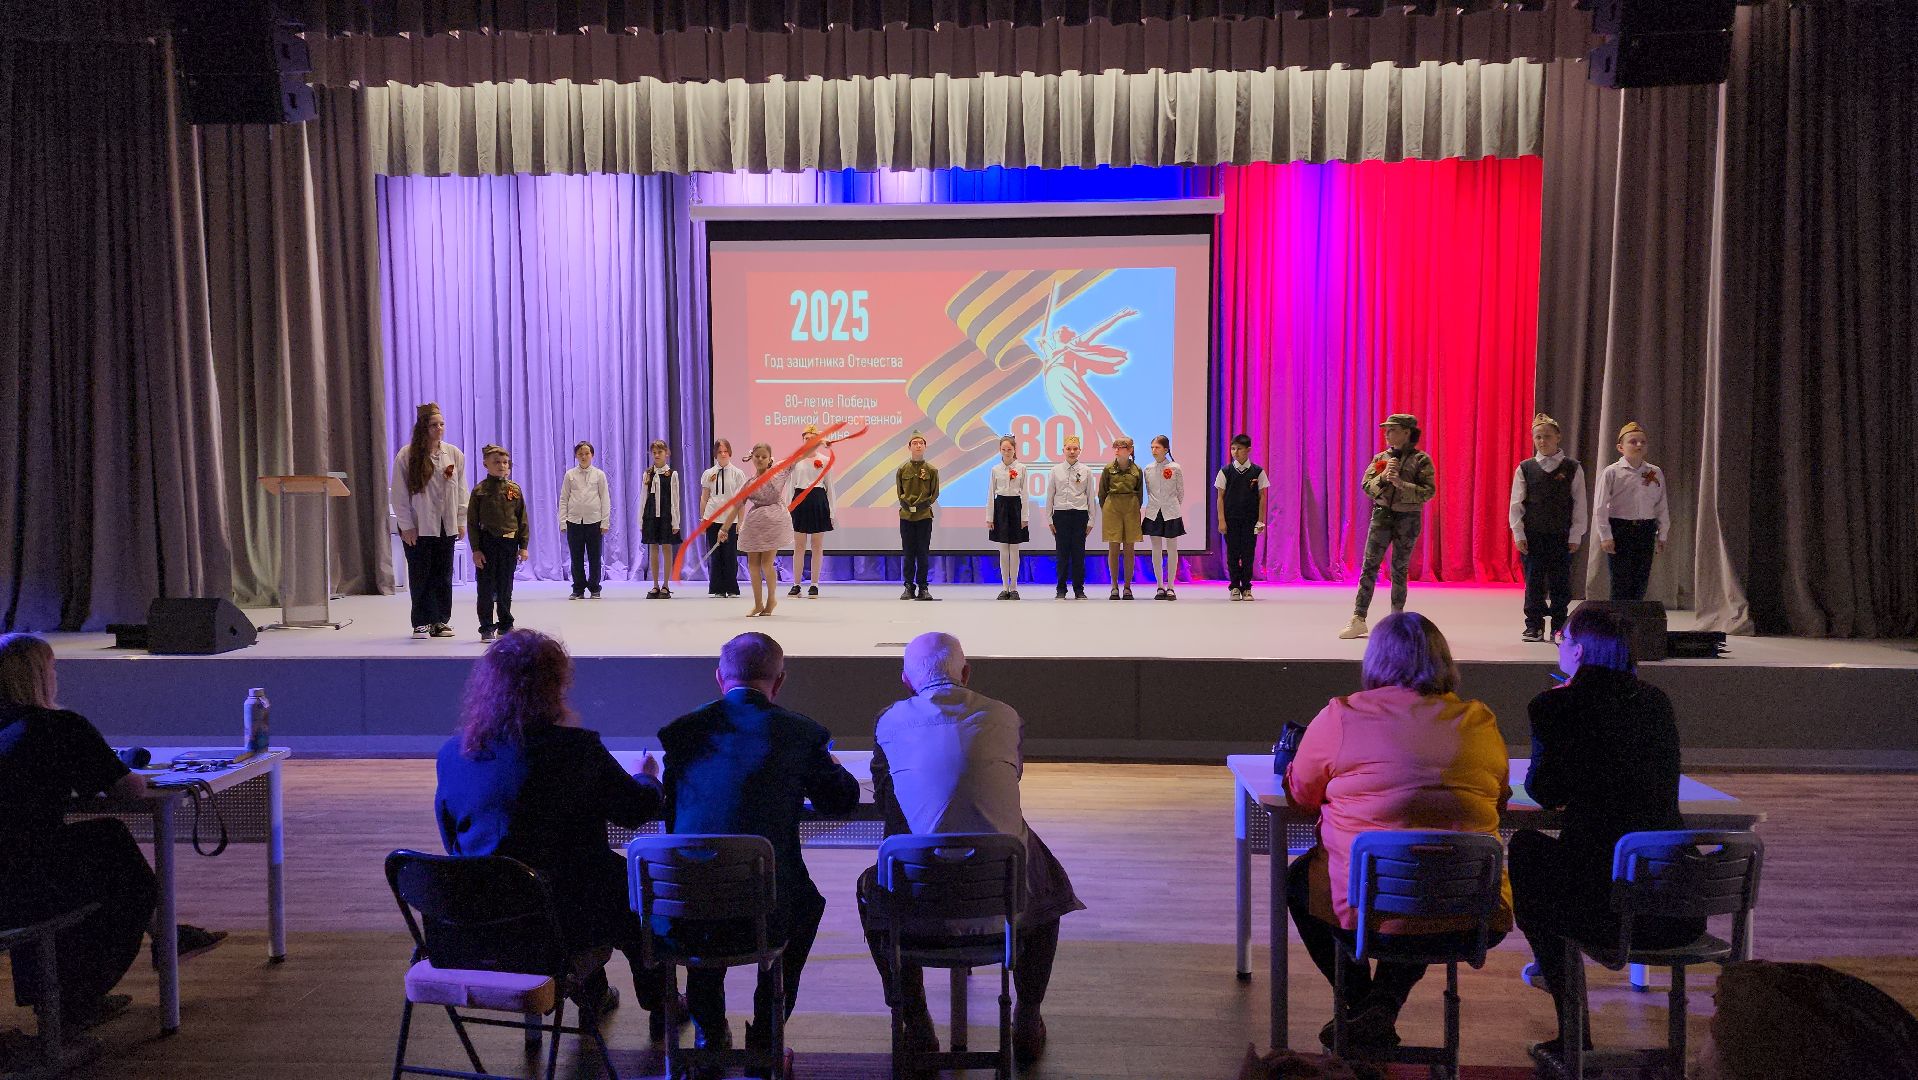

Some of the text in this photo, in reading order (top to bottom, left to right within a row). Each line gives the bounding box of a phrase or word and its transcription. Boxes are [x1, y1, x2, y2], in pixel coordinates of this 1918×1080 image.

[790, 289, 869, 341] 2025
[764, 353, 903, 369] Год защитника Отечества
[784, 394, 878, 409] 80-летие Победы
[764, 411, 902, 425] в Великой Отечественной
[1011, 415, 1076, 462] 80
